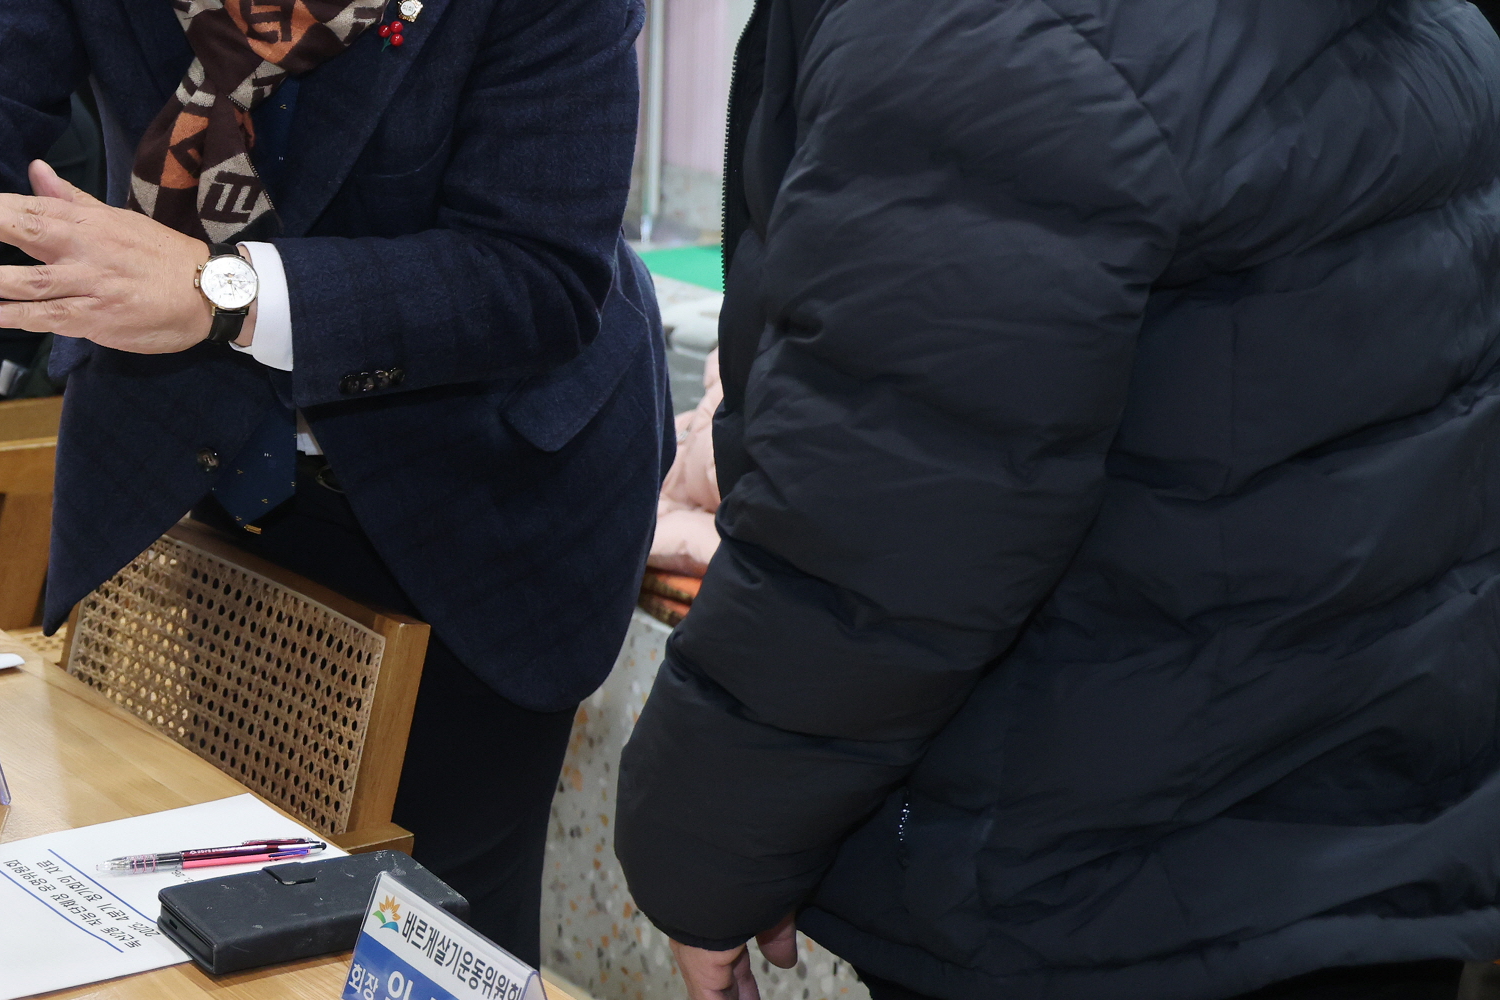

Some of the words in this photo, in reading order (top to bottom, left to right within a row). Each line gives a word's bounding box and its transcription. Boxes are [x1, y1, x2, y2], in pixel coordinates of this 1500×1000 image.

[3, 859, 57, 892] 운영위원회
[36, 859, 63, 874] 자료
[57, 875, 103, 902] 정기회의
[50, 893, 102, 926] 직능단체장
[97, 903, 130, 921] 4분기
[100, 926, 142, 949] 독산2동
[348, 963, 379, 1000] 회장
